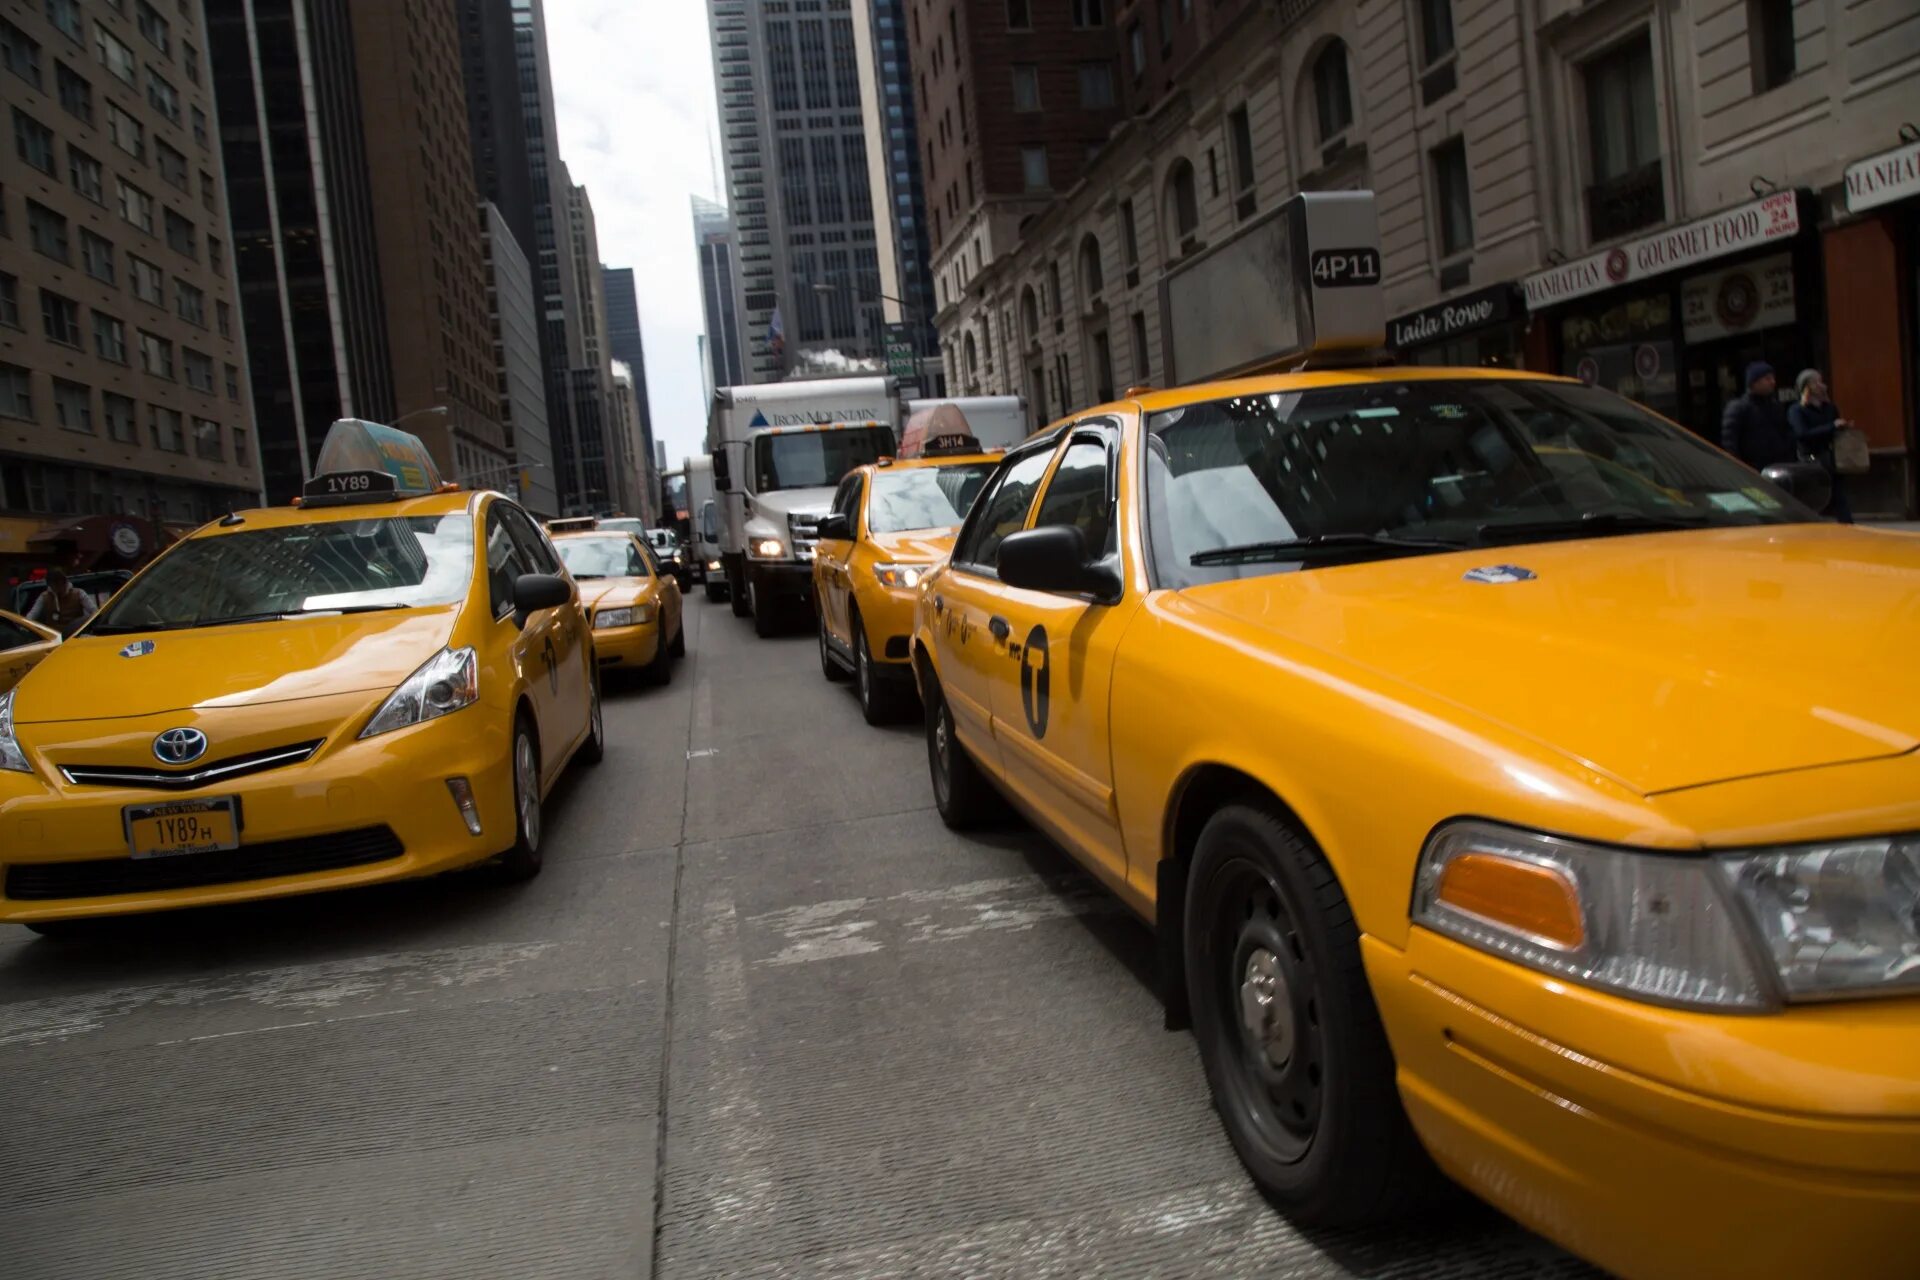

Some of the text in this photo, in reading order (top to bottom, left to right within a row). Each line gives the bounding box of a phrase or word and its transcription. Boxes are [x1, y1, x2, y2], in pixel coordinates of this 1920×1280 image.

[1762, 191, 1792, 210] OPEN
[1770, 209, 1788, 224] 24
[1525, 210, 1759, 302] MANHATTAN GOURMET FOOD
[1313, 253, 1377, 280] 4P11
[1395, 300, 1493, 346] Laila Rowe
[773, 408, 876, 427] IRON MOUNTAIN
[938, 434, 964, 448] 3H14
[327, 475, 370, 493] 1Y89
